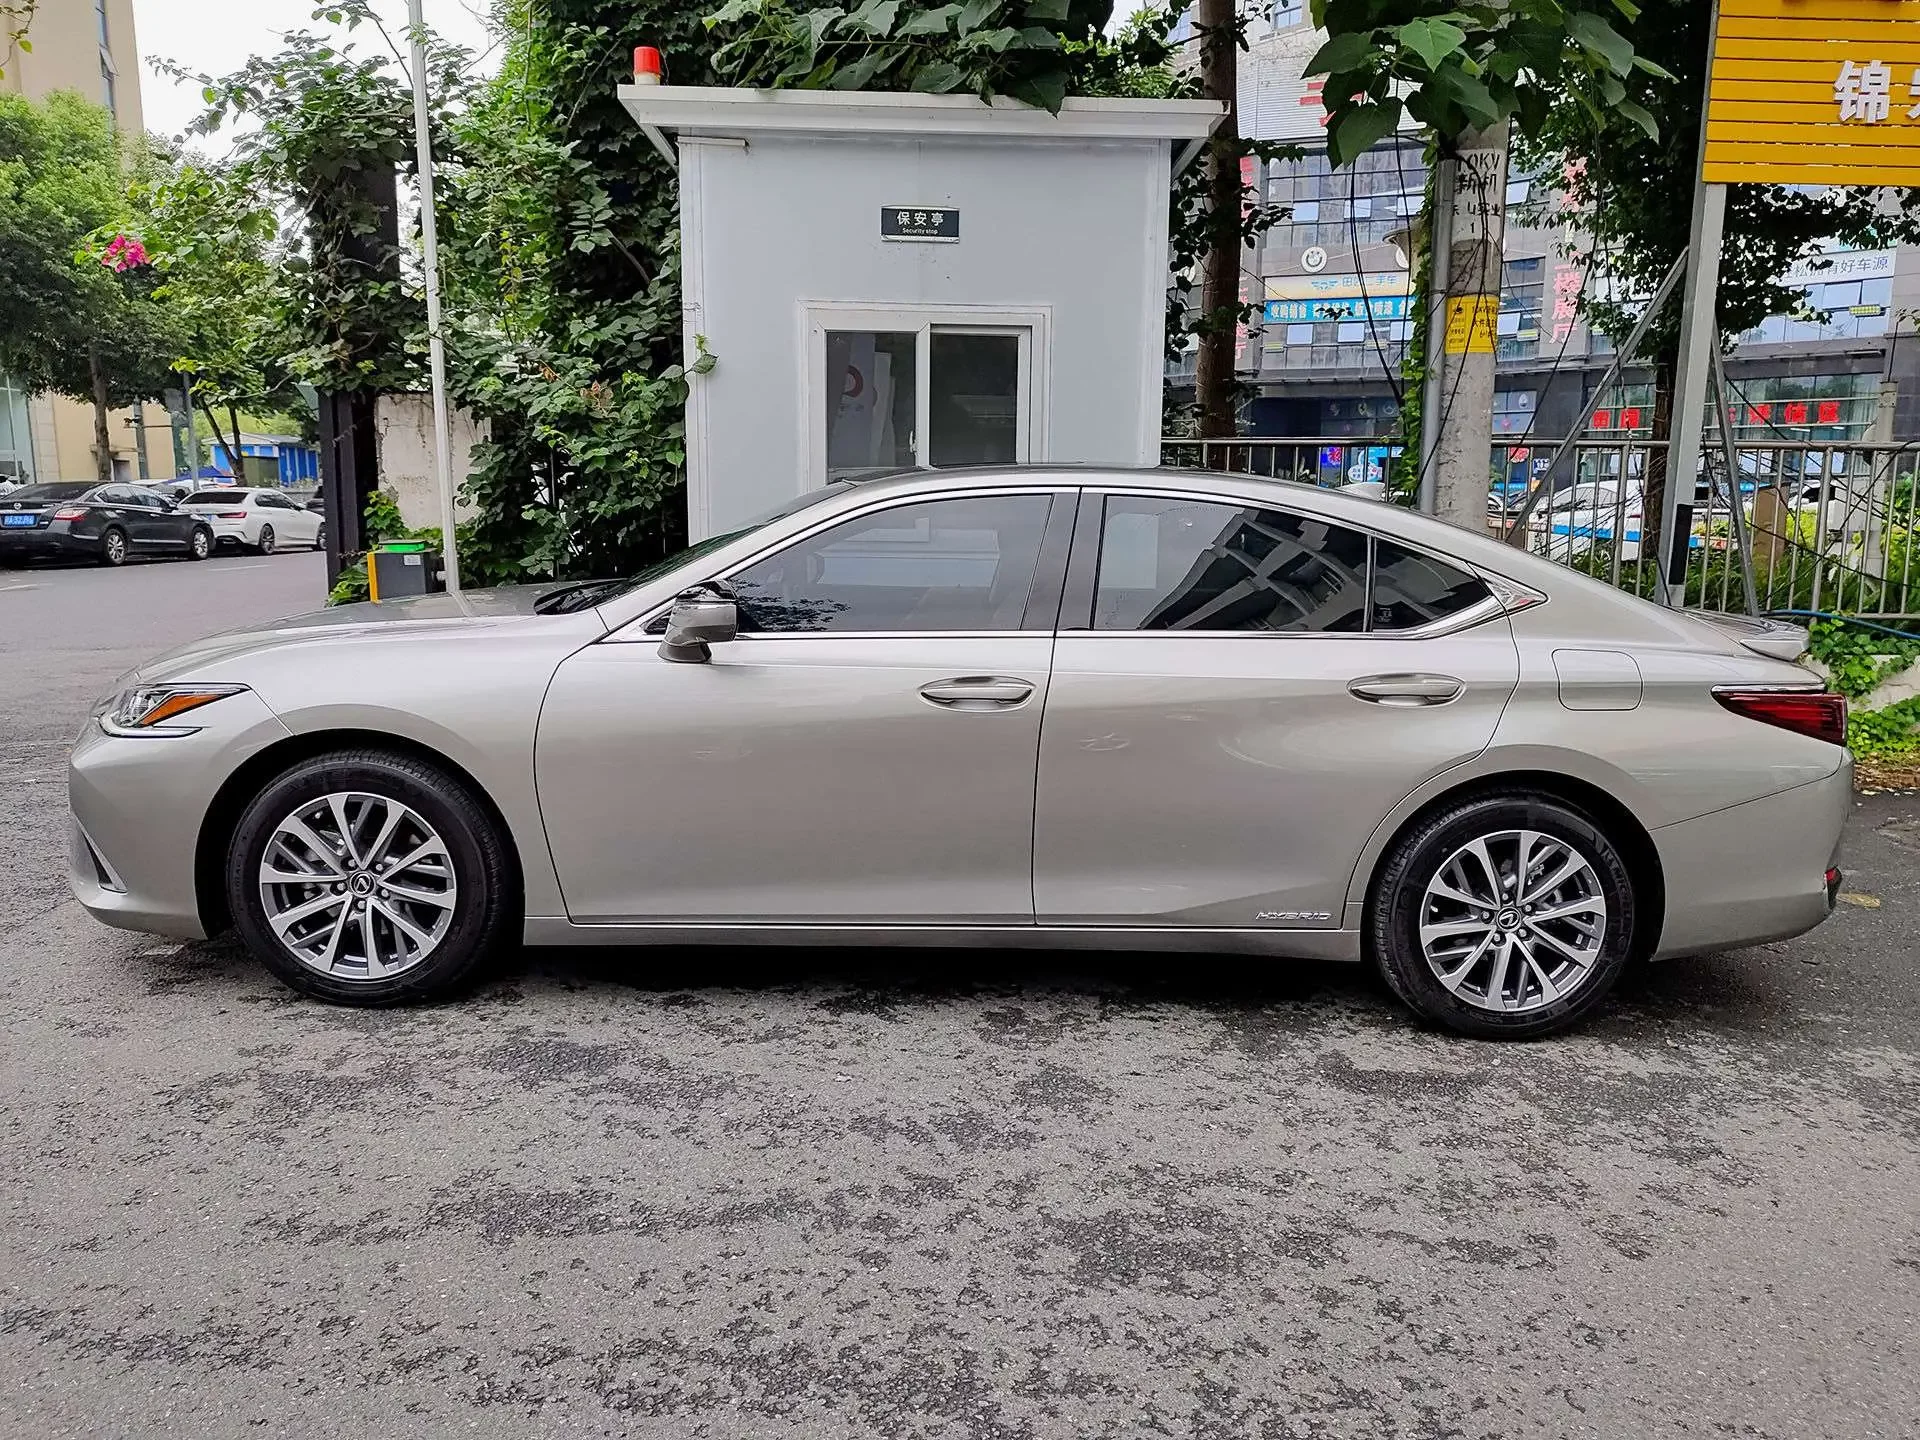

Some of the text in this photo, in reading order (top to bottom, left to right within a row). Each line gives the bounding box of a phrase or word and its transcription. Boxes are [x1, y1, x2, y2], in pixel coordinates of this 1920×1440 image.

[896, 211, 944, 227] 保安亭
[1255, 911, 1331, 920] HYBRID
